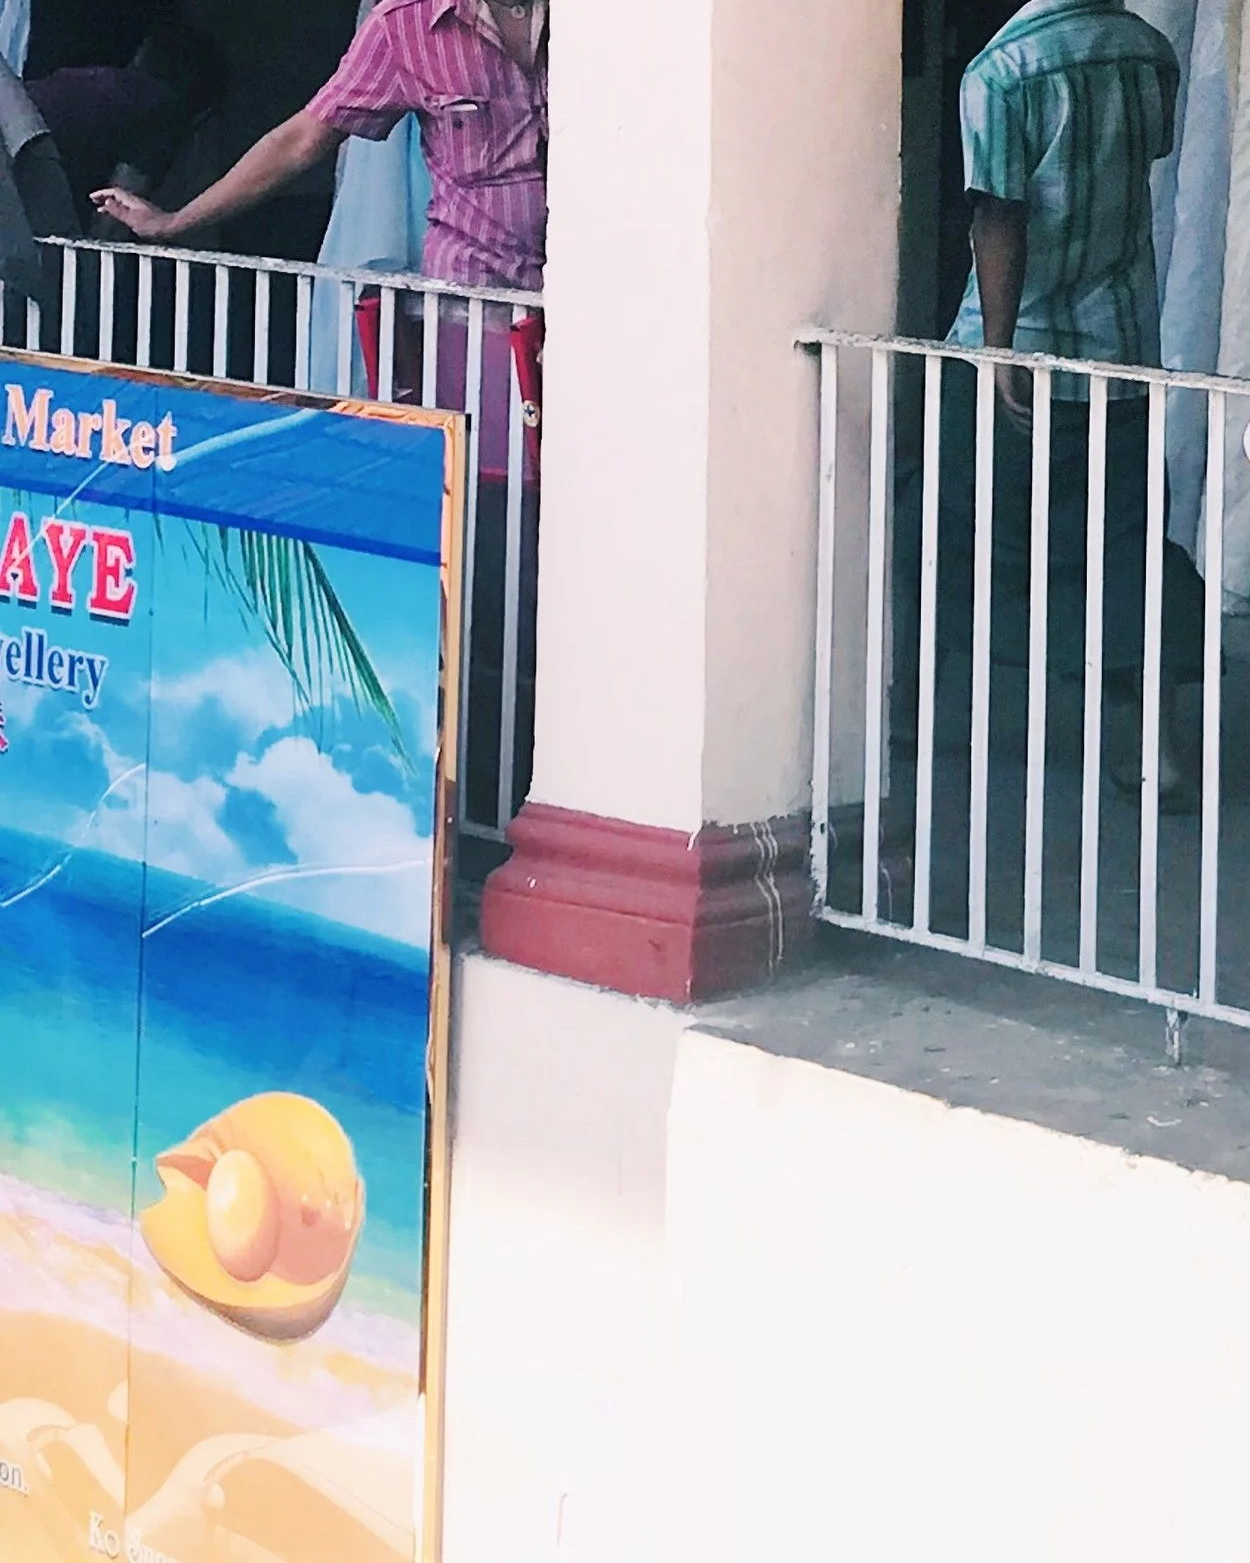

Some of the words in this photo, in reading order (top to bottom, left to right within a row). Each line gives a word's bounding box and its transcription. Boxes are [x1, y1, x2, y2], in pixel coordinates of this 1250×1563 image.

[2, 383, 177, 471] Market
[0, 511, 138, 622] AYE
[0, 626, 109, 710] ellery
